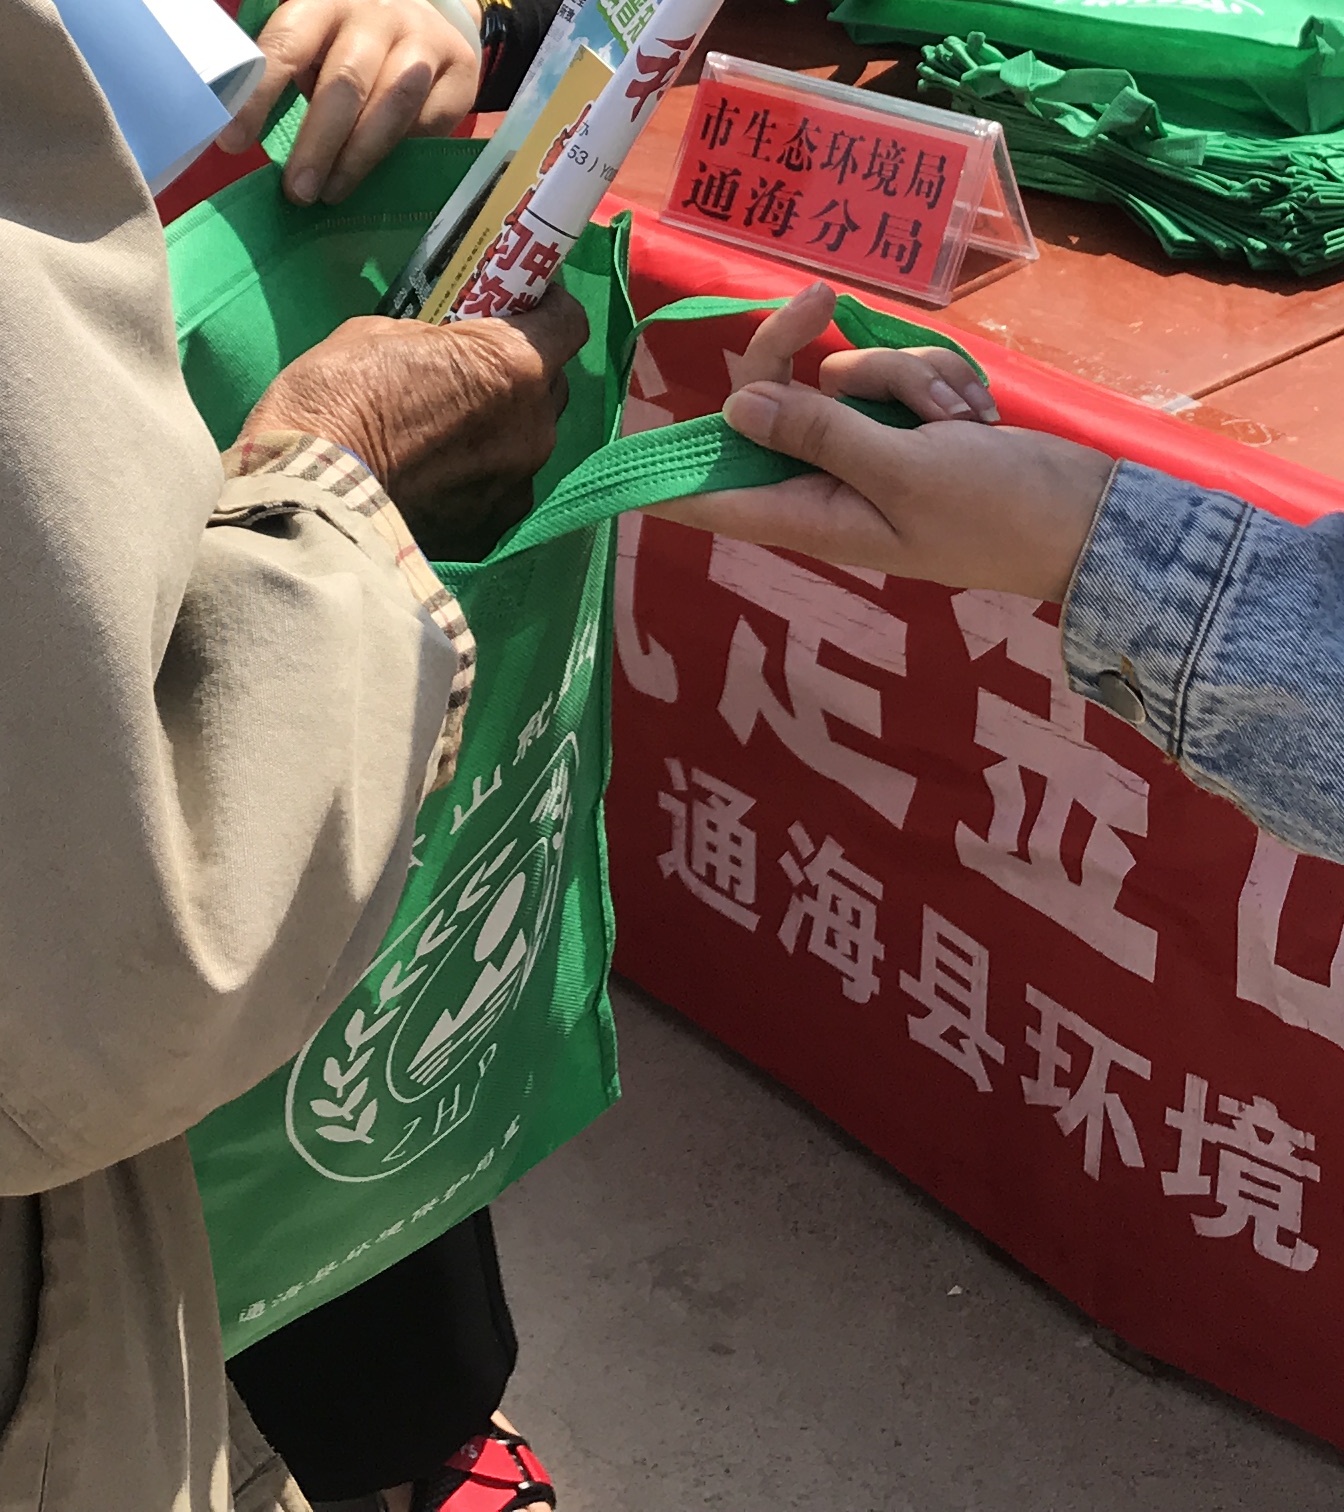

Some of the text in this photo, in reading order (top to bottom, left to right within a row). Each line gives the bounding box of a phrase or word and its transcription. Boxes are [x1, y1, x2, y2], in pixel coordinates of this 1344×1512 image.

[701, 97, 948, 210] 市生态环境局
[681, 159, 925, 275] 通海分局
